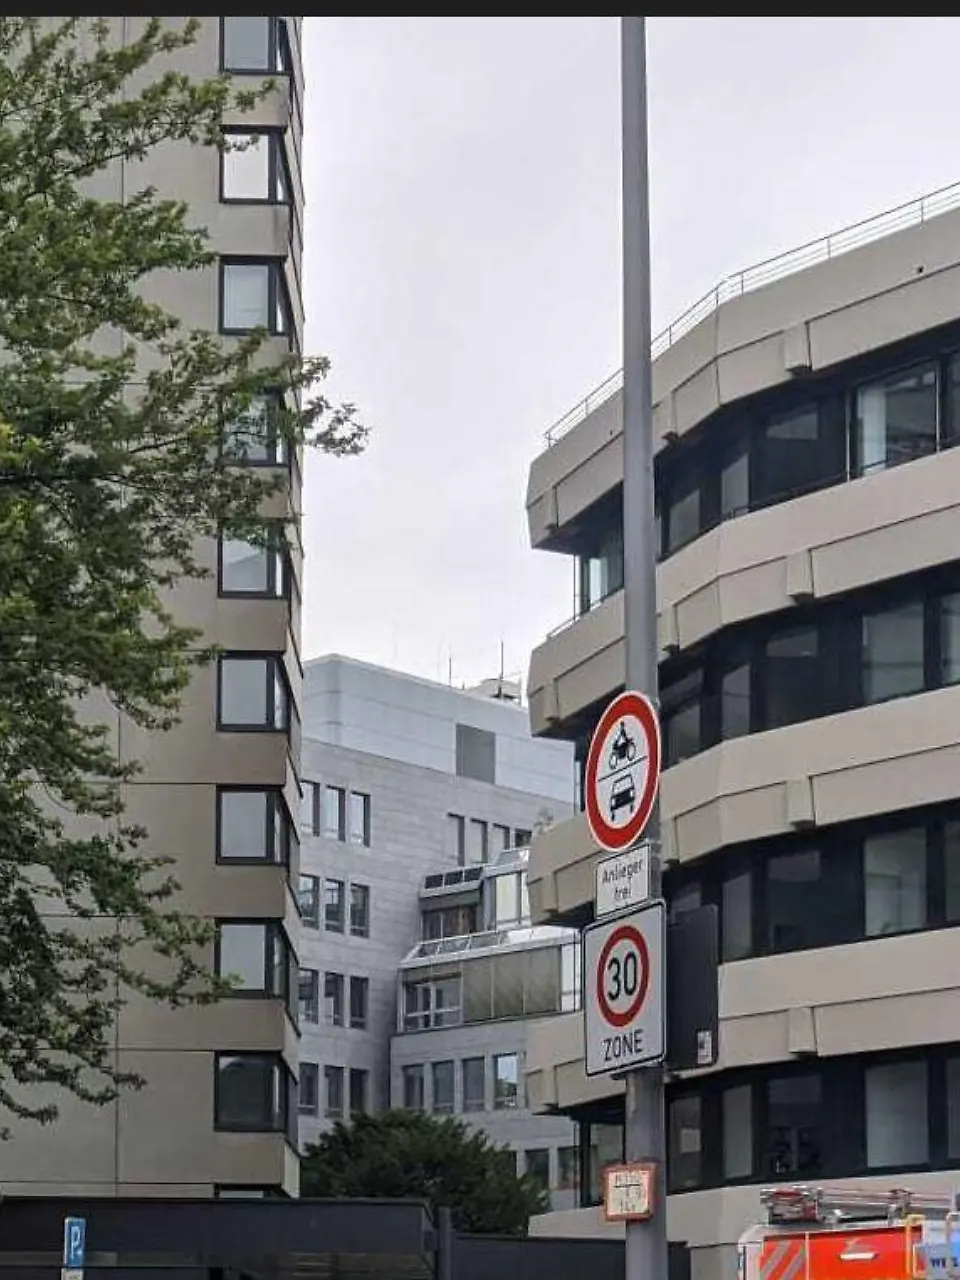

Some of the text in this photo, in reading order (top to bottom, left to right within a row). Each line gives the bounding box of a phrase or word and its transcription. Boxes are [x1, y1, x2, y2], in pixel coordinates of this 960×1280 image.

[602, 860, 642, 883] Anlieger
[614, 886, 632, 900] frei
[608, 951, 637, 1001] 30
[603, 1030, 643, 1061] ZONE
[70, 1226, 81, 1260] P
